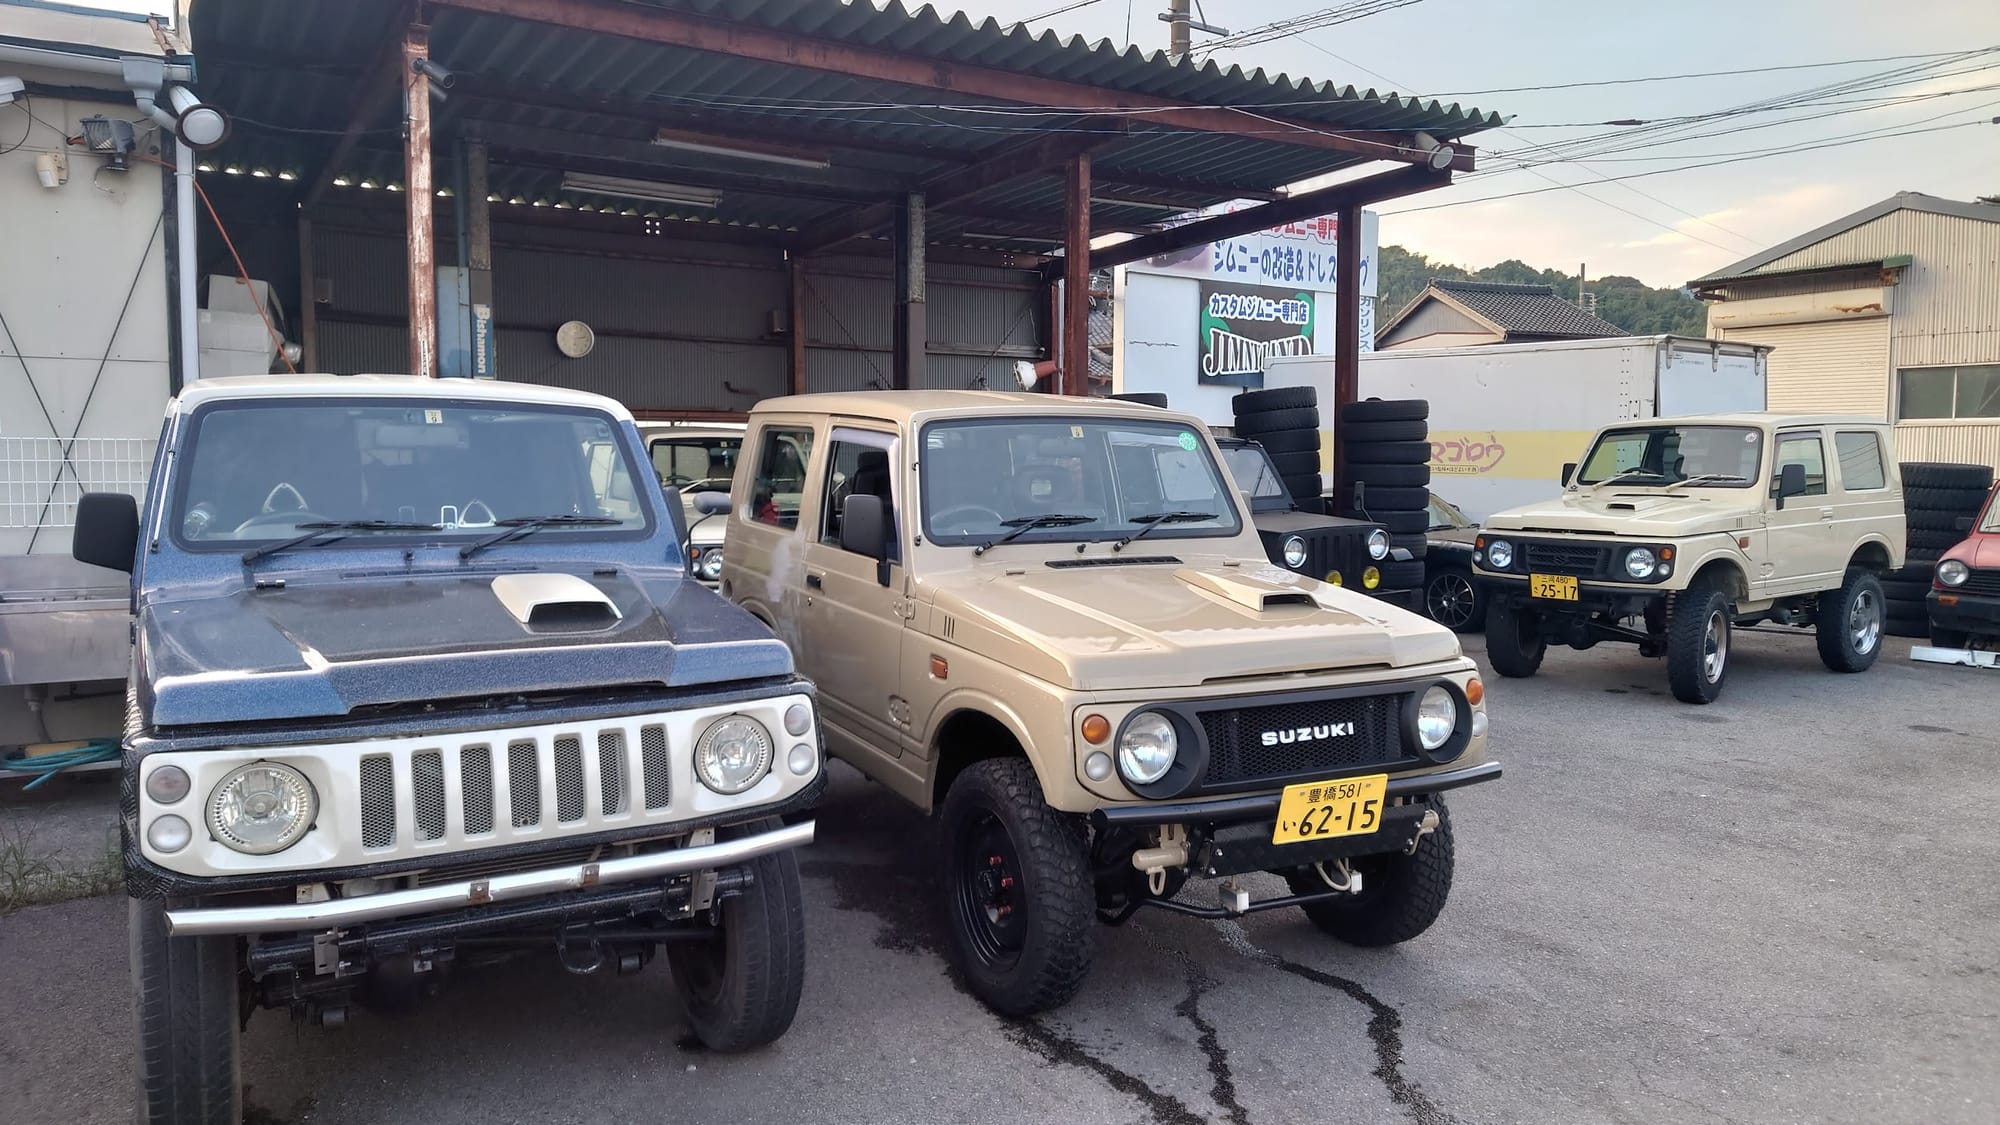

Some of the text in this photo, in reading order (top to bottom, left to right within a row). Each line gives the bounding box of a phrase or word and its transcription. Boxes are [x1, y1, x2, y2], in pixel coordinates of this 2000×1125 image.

[1209, 294, 1308, 322] カスタムジムニー専門店
[474, 304, 490, 373] Bishamon
[1541, 584, 1577, 600] 25-17
[1261, 722, 1354, 746] SUZUKI
[1299, 800, 1378, 836] 62-15
